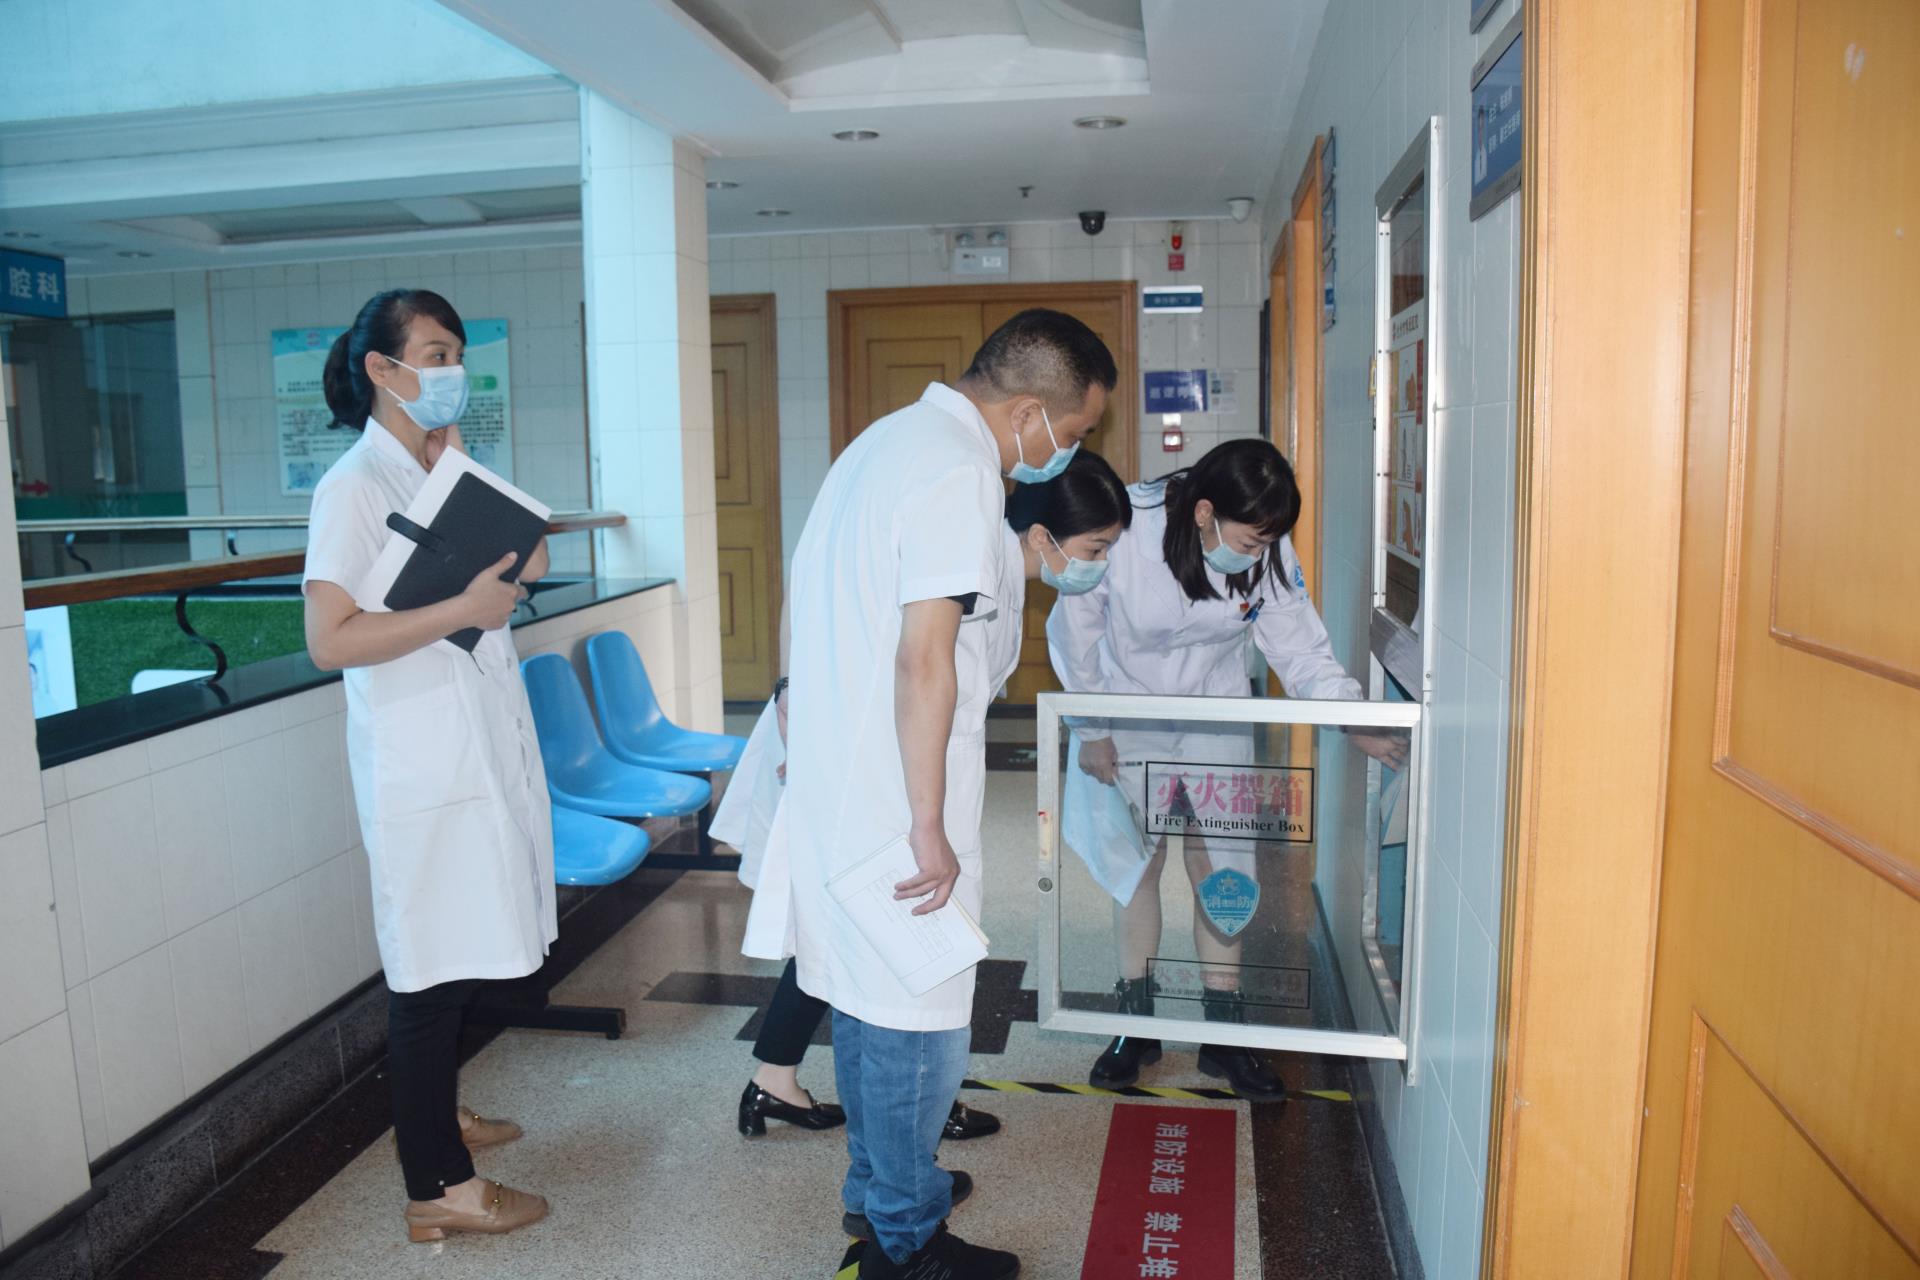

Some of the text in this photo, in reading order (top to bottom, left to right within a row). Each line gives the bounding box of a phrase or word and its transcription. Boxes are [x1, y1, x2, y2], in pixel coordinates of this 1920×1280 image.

[0, 266, 60, 303] 腔科
[1157, 771, 1304, 817] 灭火器箱
[1155, 813, 1305, 833] Fire Extinguisher Box
[1138, 1122, 1189, 1279] 消防设施 禁止堆
